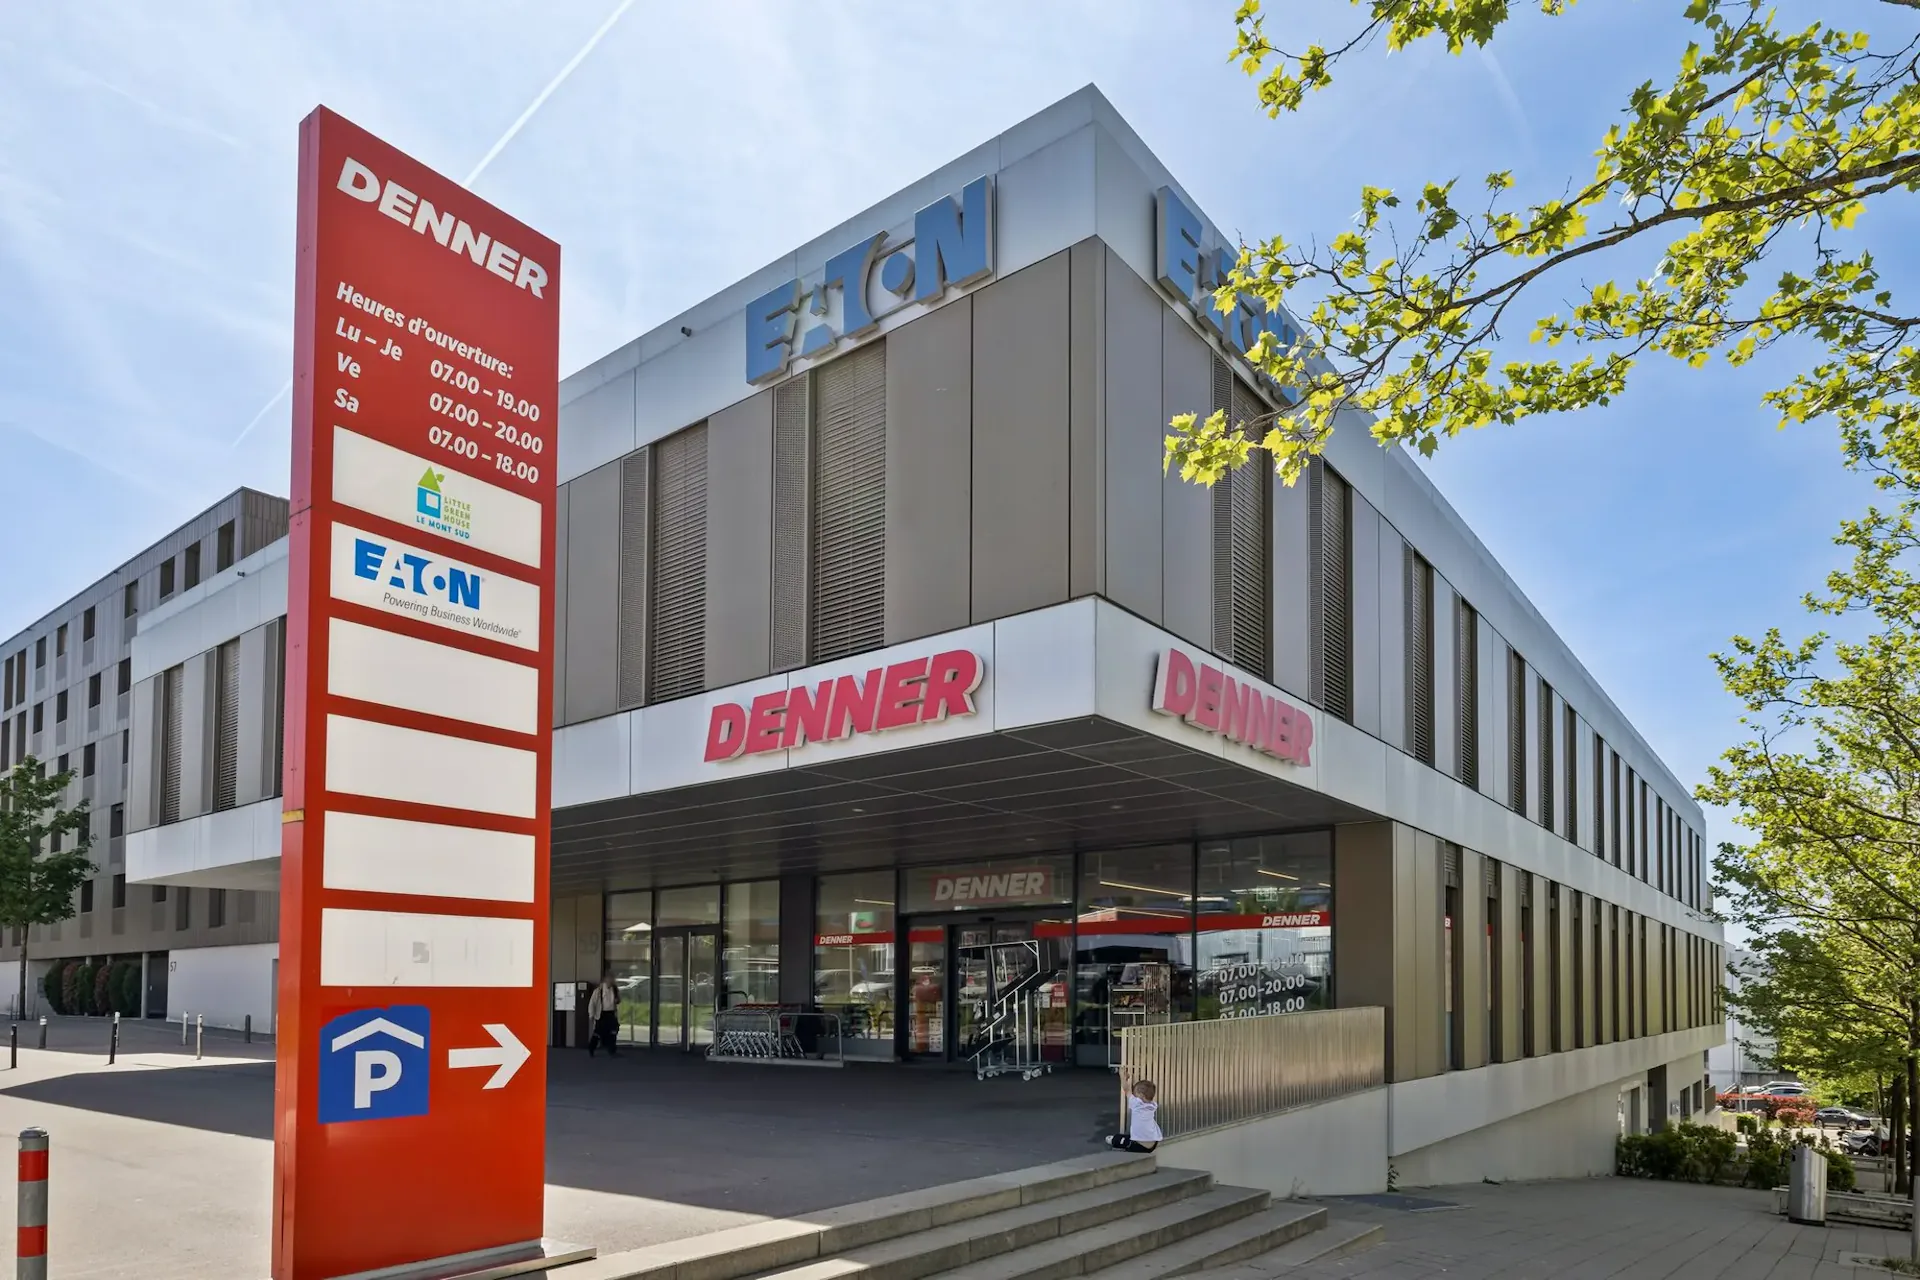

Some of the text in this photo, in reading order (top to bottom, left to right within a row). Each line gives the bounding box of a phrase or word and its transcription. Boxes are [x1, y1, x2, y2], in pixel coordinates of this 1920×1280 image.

[336, 156, 548, 299] DENNER
[746, 174, 994, 386] EATON
[336, 281, 513, 379] Heures d’ouverture:
[335, 316, 361, 343] Lu
[380, 338, 403, 361] Je
[430, 359, 480, 395] 07.00
[497, 389, 540, 422] 19.00
[337, 352, 361, 378] Ve
[429, 393, 479, 427] 07.00
[495, 421, 543, 454] 20.00
[334, 388, 359, 413] Sa
[428, 426, 478, 459] 07.00
[496, 453, 539, 484] 18.00
[416, 515, 470, 539] LE MONT SUD
[444, 496, 471, 511] LITTLE
[444, 505, 470, 520] GREEN
[444, 514, 470, 529] HOUSE
[355, 538, 480, 610] EATON
[383, 592, 520, 638] Powering Business Worldwide
[703, 649, 984, 763] DENNER
[1153, 648, 1313, 767] DENNER
[935, 872, 1044, 900] DENNER
[819, 935, 853, 945] DENNER
[1262, 914, 1320, 927] DENNER
[170, 961, 177, 973] 57
[354, 1050, 402, 1109] P
